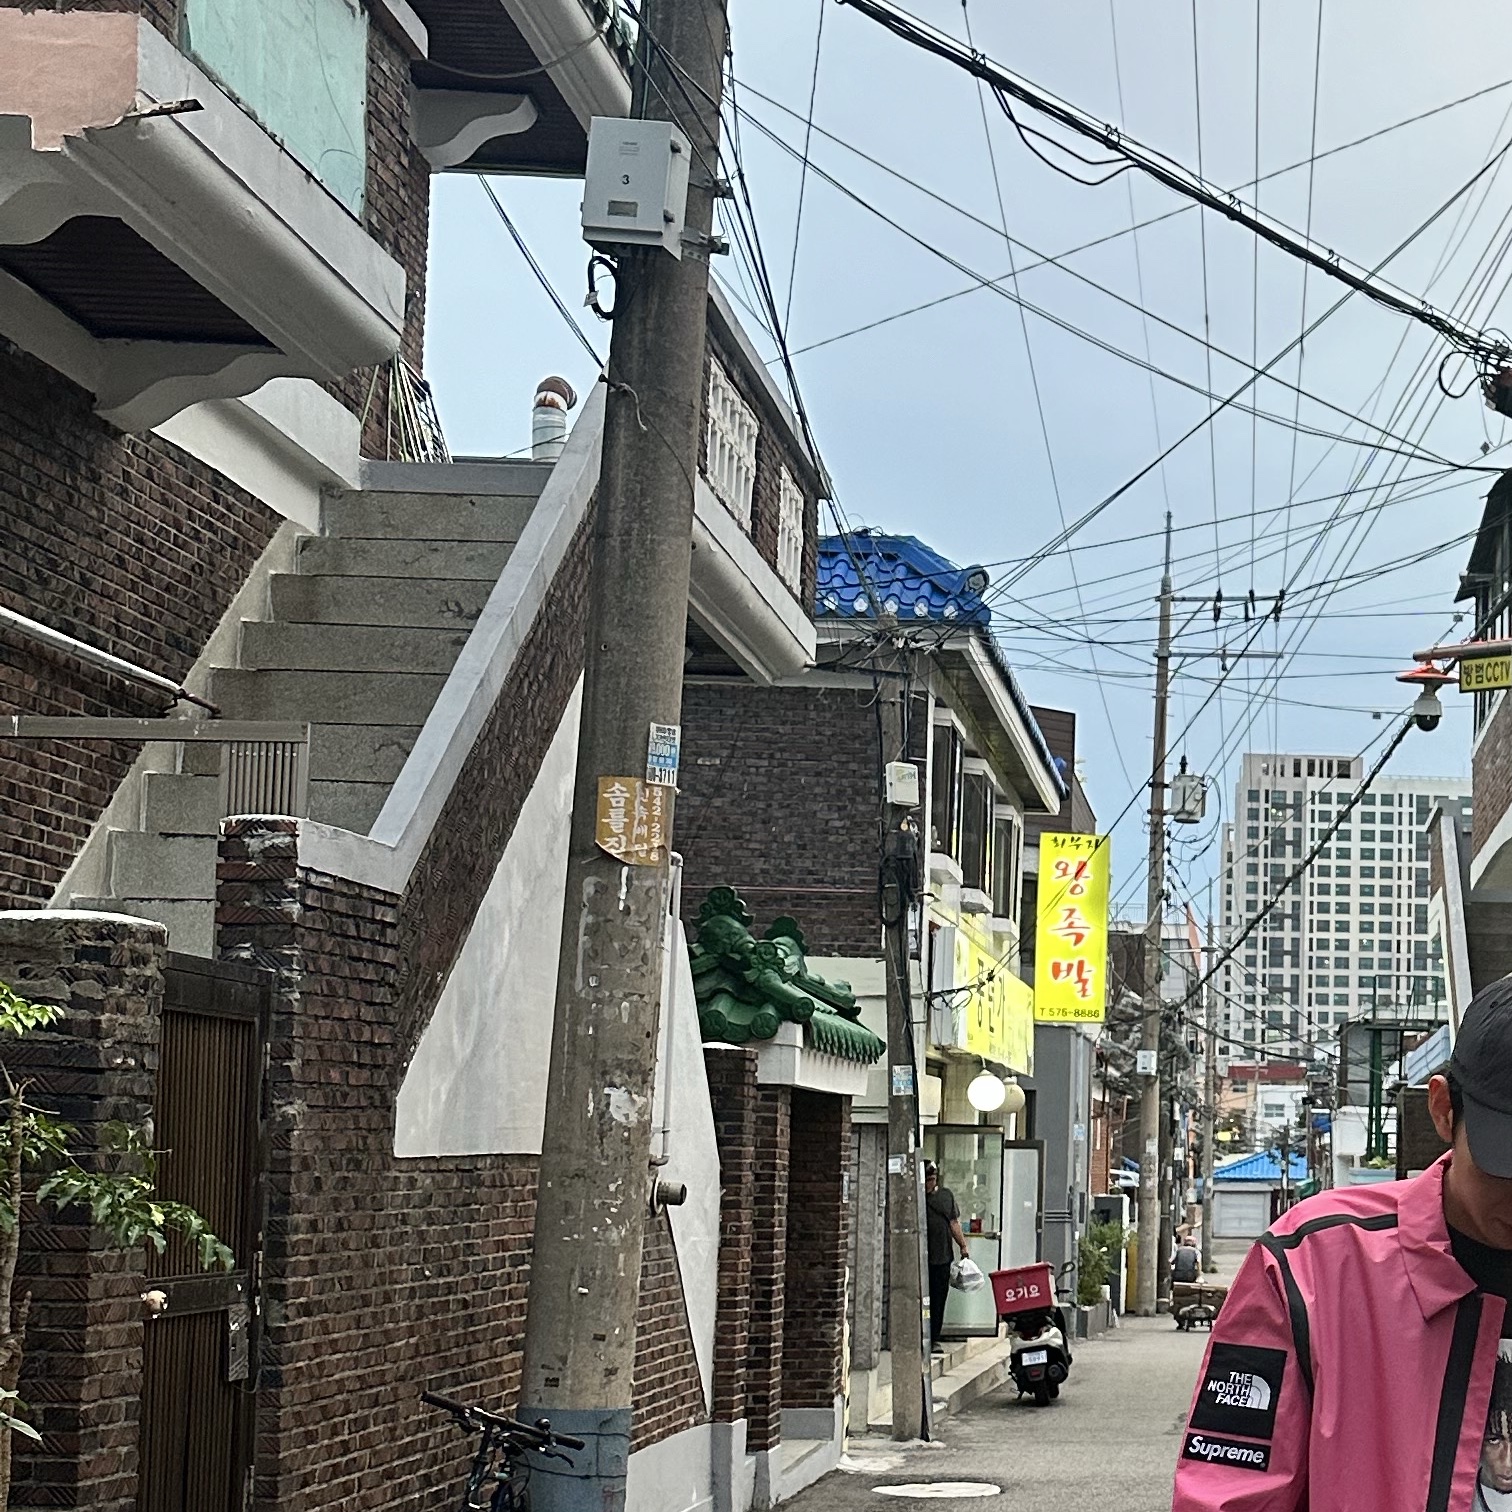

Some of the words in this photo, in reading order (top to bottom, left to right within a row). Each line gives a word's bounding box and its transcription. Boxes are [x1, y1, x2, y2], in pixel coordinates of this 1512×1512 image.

[622, 174, 630, 185] 3
[1050, 860, 1094, 999] 왕족발
[1005, 1284, 1040, 1302] 요기요
[1229, 1371, 1252, 1385] THE
[1207, 1379, 1251, 1398] NORTH
[1214, 1393, 1250, 1408] FACE
[1188, 1435, 1265, 1464] Supreme
